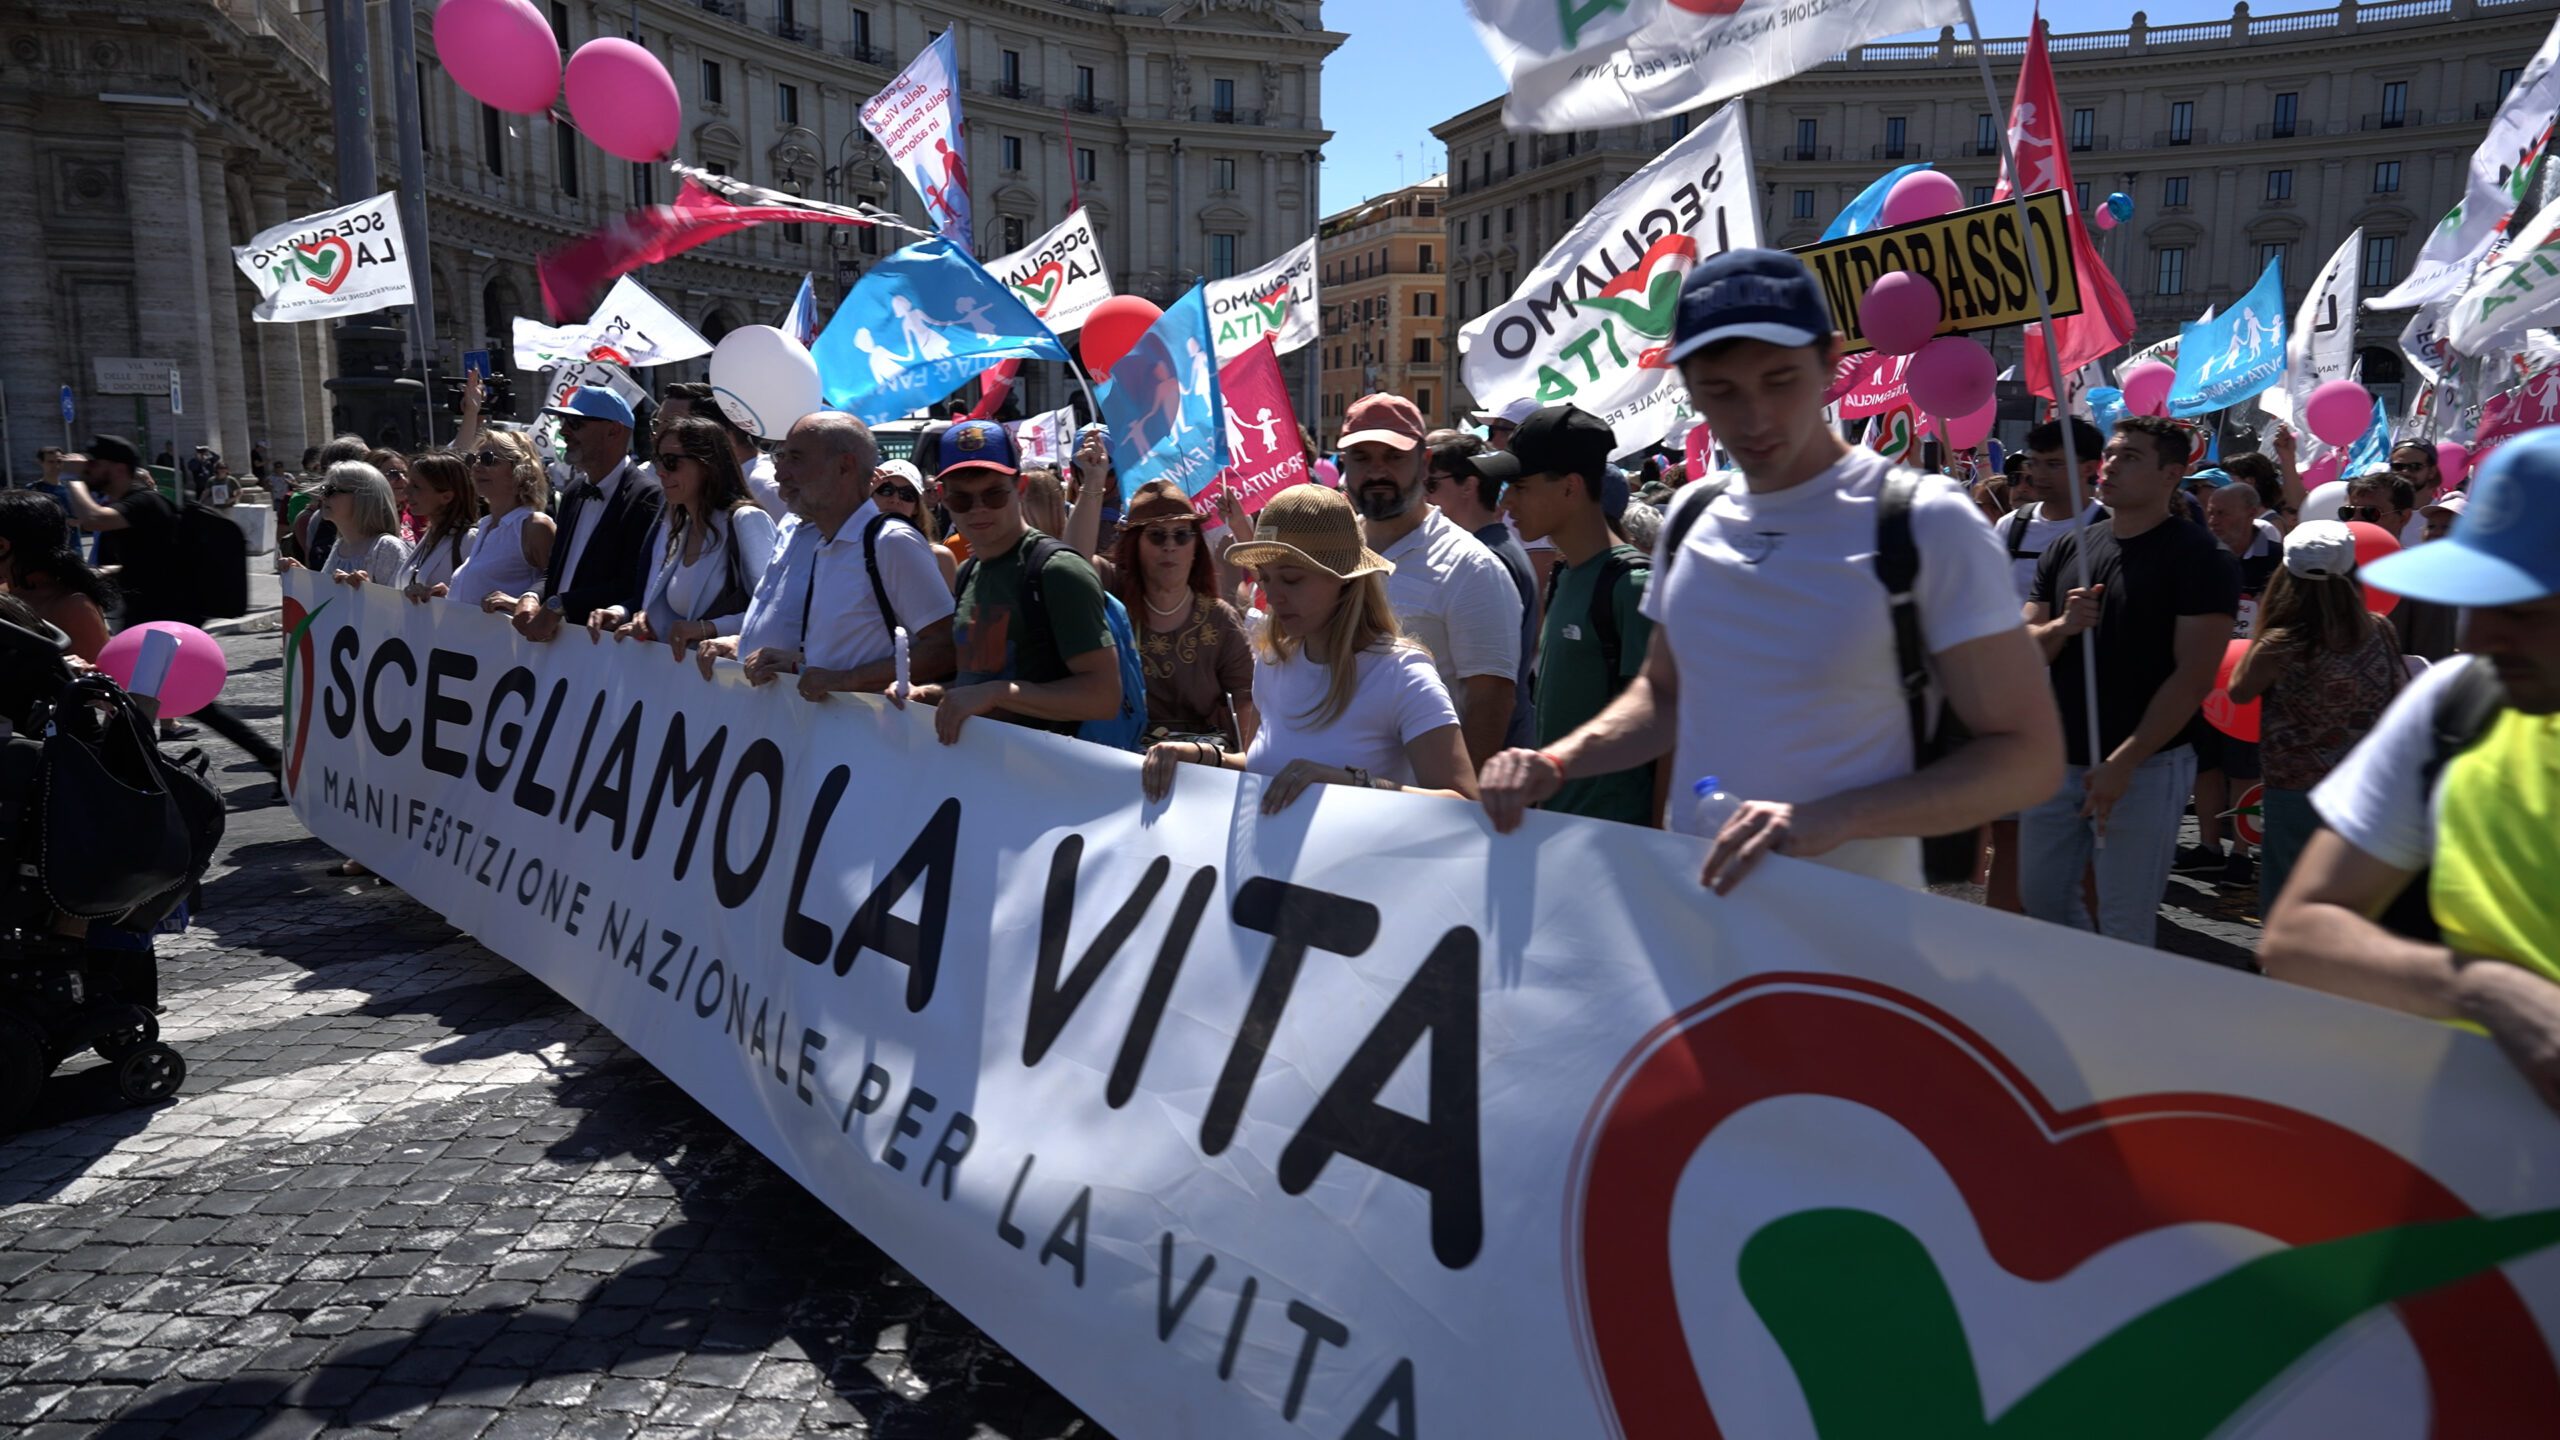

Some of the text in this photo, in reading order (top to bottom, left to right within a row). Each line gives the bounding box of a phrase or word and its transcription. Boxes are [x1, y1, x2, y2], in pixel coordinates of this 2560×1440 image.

[126, 362, 144, 370] VIA
[323, 766, 1419, 1440] MANIFESTZIONE NAZIONALE PER LA VITA
[1022, 833, 1484, 1270] VITA
